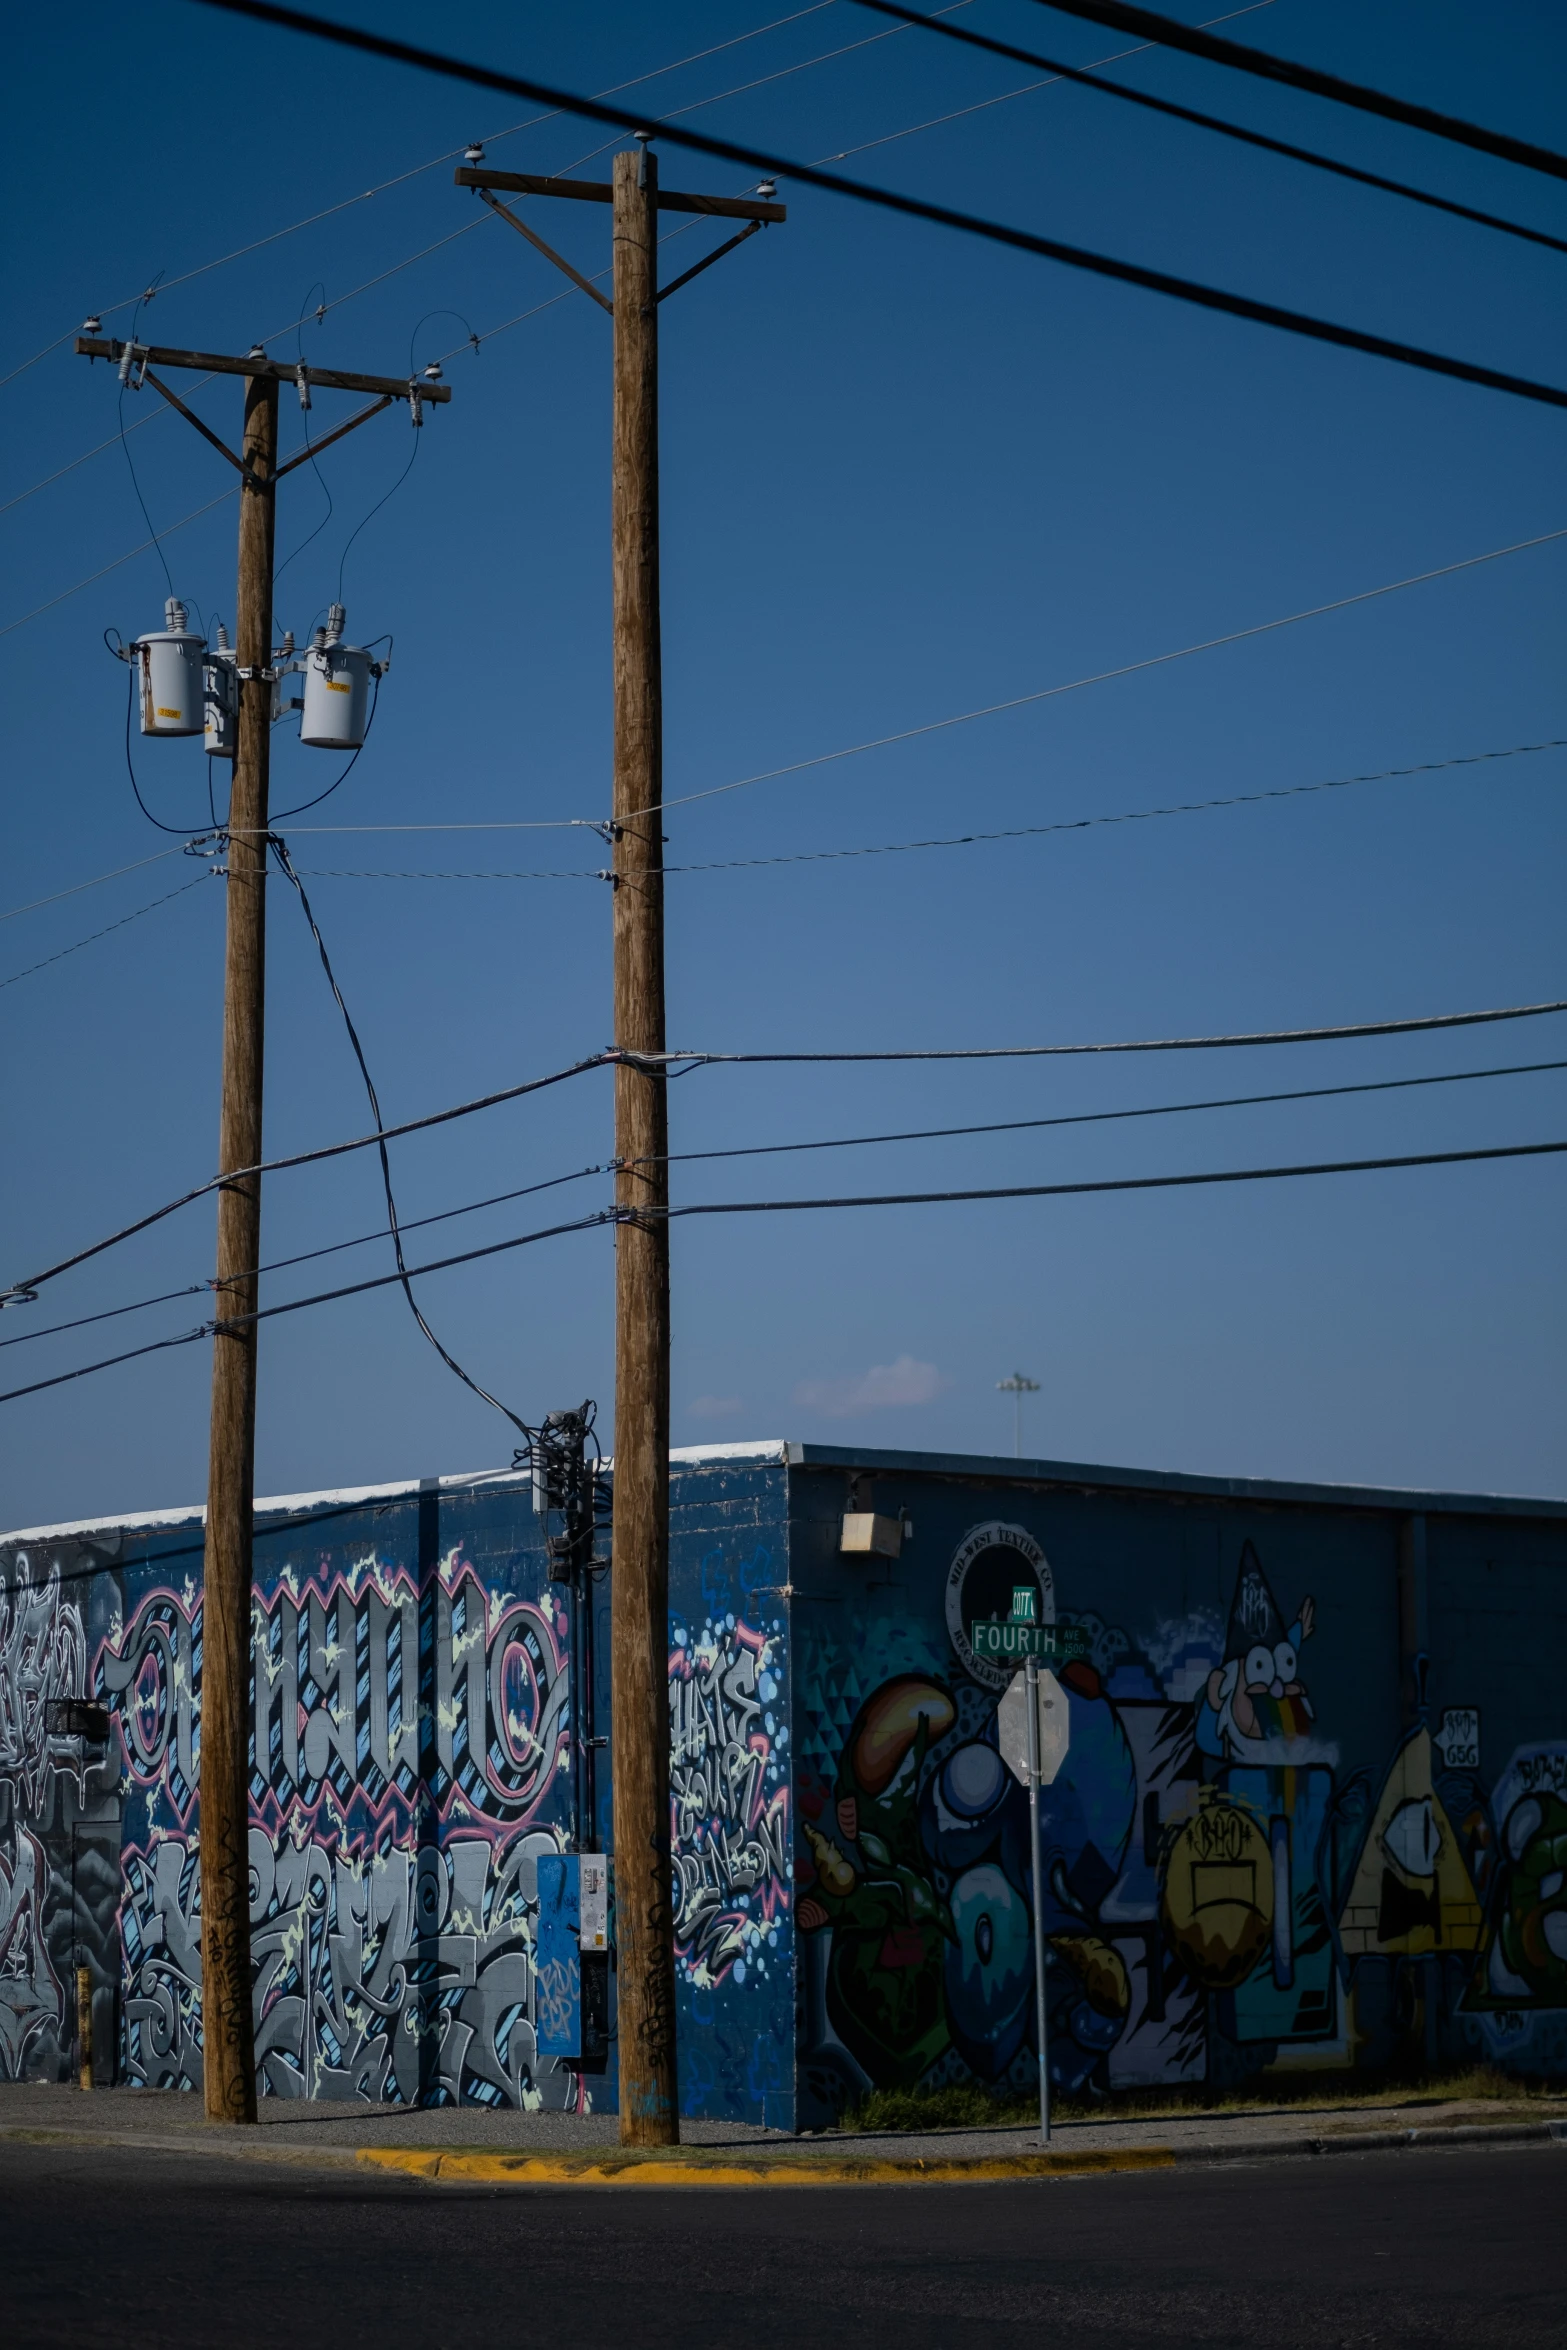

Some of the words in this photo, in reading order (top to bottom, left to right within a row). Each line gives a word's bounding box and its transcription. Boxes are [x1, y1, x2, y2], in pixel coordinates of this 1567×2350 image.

[949, 1530, 992, 1587] MID-WEST
[997, 1526, 1042, 1566] TEXTILE
[953, 1629, 1001, 1685] RECYCLED
[974, 1625, 1056, 1653] FOURTH
[1064, 1629, 1080, 1641] AVE
[1064, 1643, 1085, 1655] 1500
